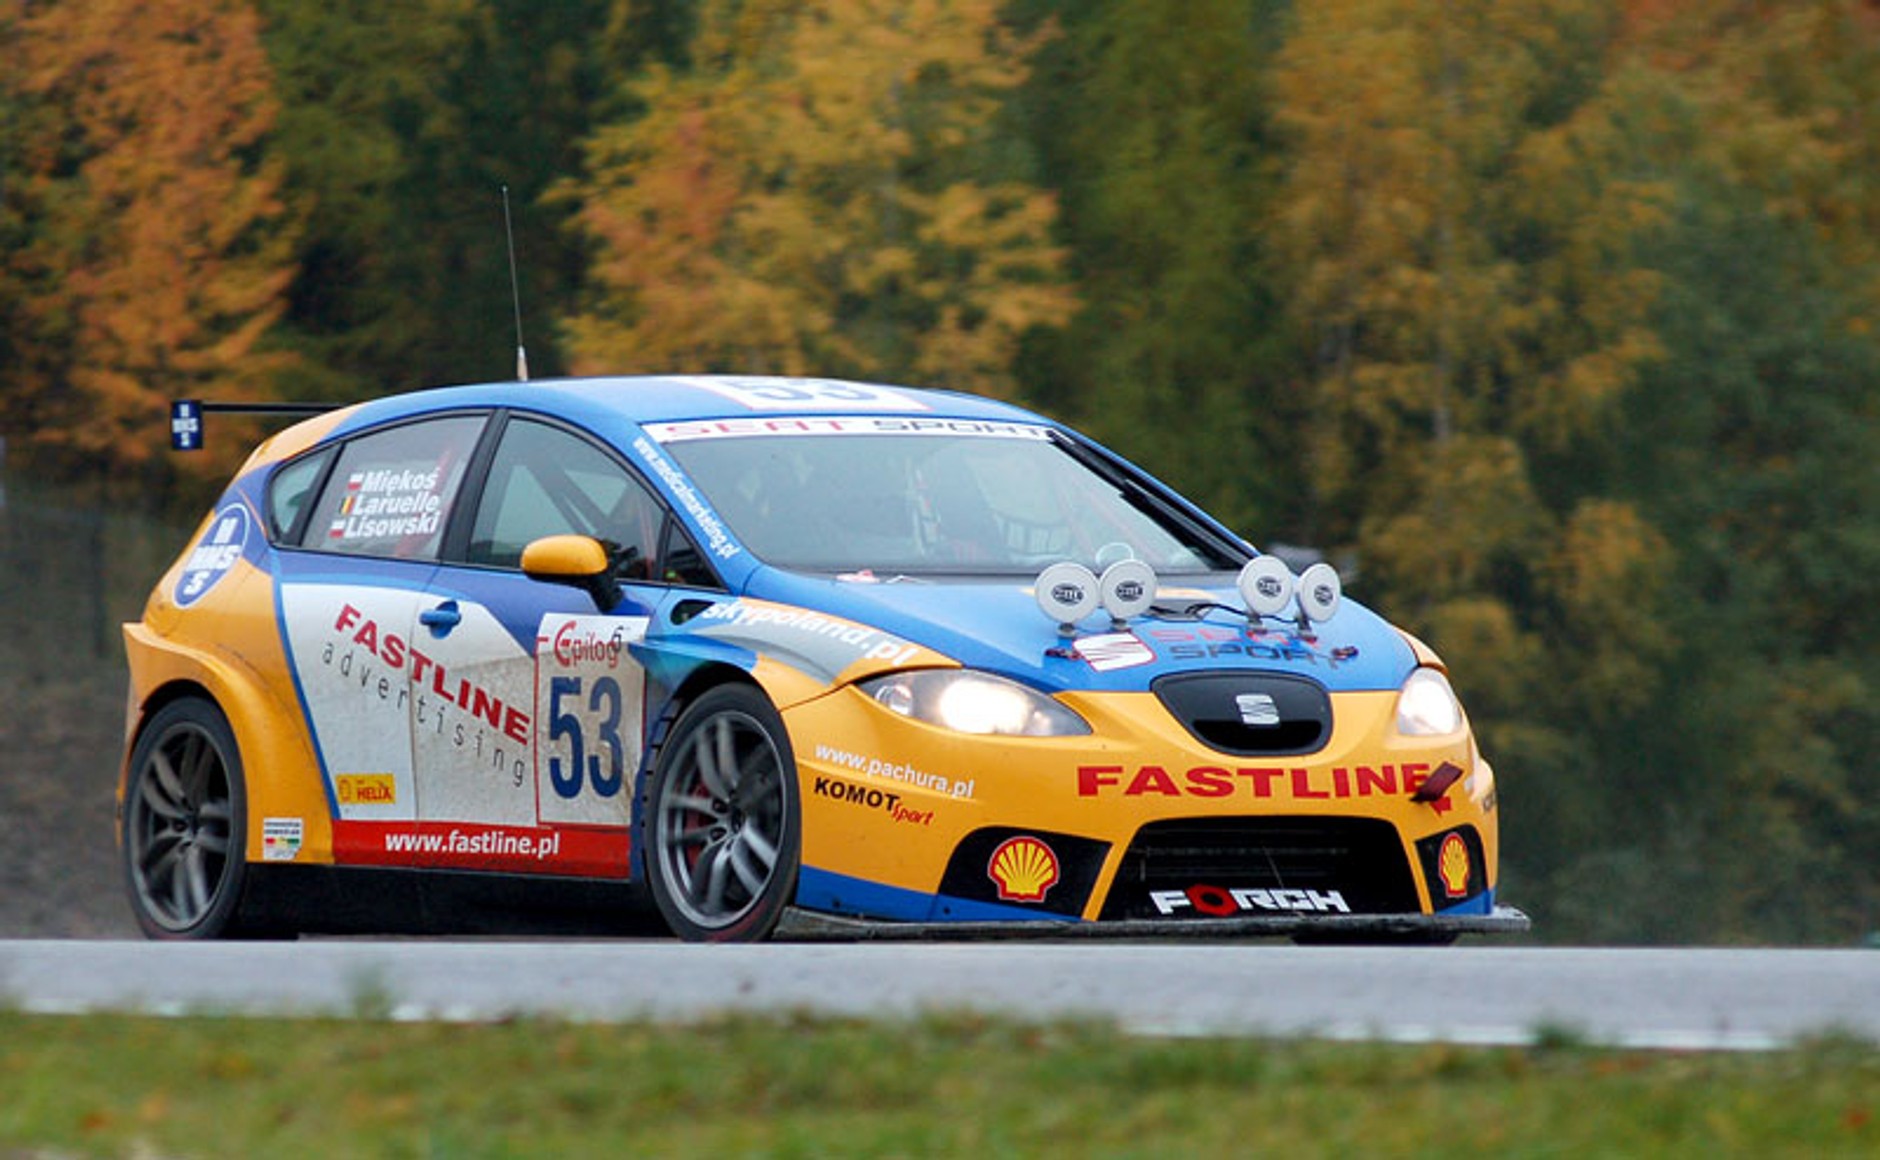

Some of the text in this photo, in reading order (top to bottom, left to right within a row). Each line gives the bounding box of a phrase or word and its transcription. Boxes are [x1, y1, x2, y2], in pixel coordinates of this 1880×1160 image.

[665, 420, 1042, 438] SEAT SPORT
[343, 511, 442, 539] Lisowski
[353, 491, 440, 516] Laruelle
[701, 600, 918, 666] skypoland.pl
[334, 603, 530, 746] FASTLINE
[321, 641, 526, 788] advertising
[550, 675, 624, 800] 53
[815, 743, 975, 799] www.pachura.pl
[1077, 763, 1432, 798] FASTLINE
[385, 829, 560, 860] www.fastline.pl
